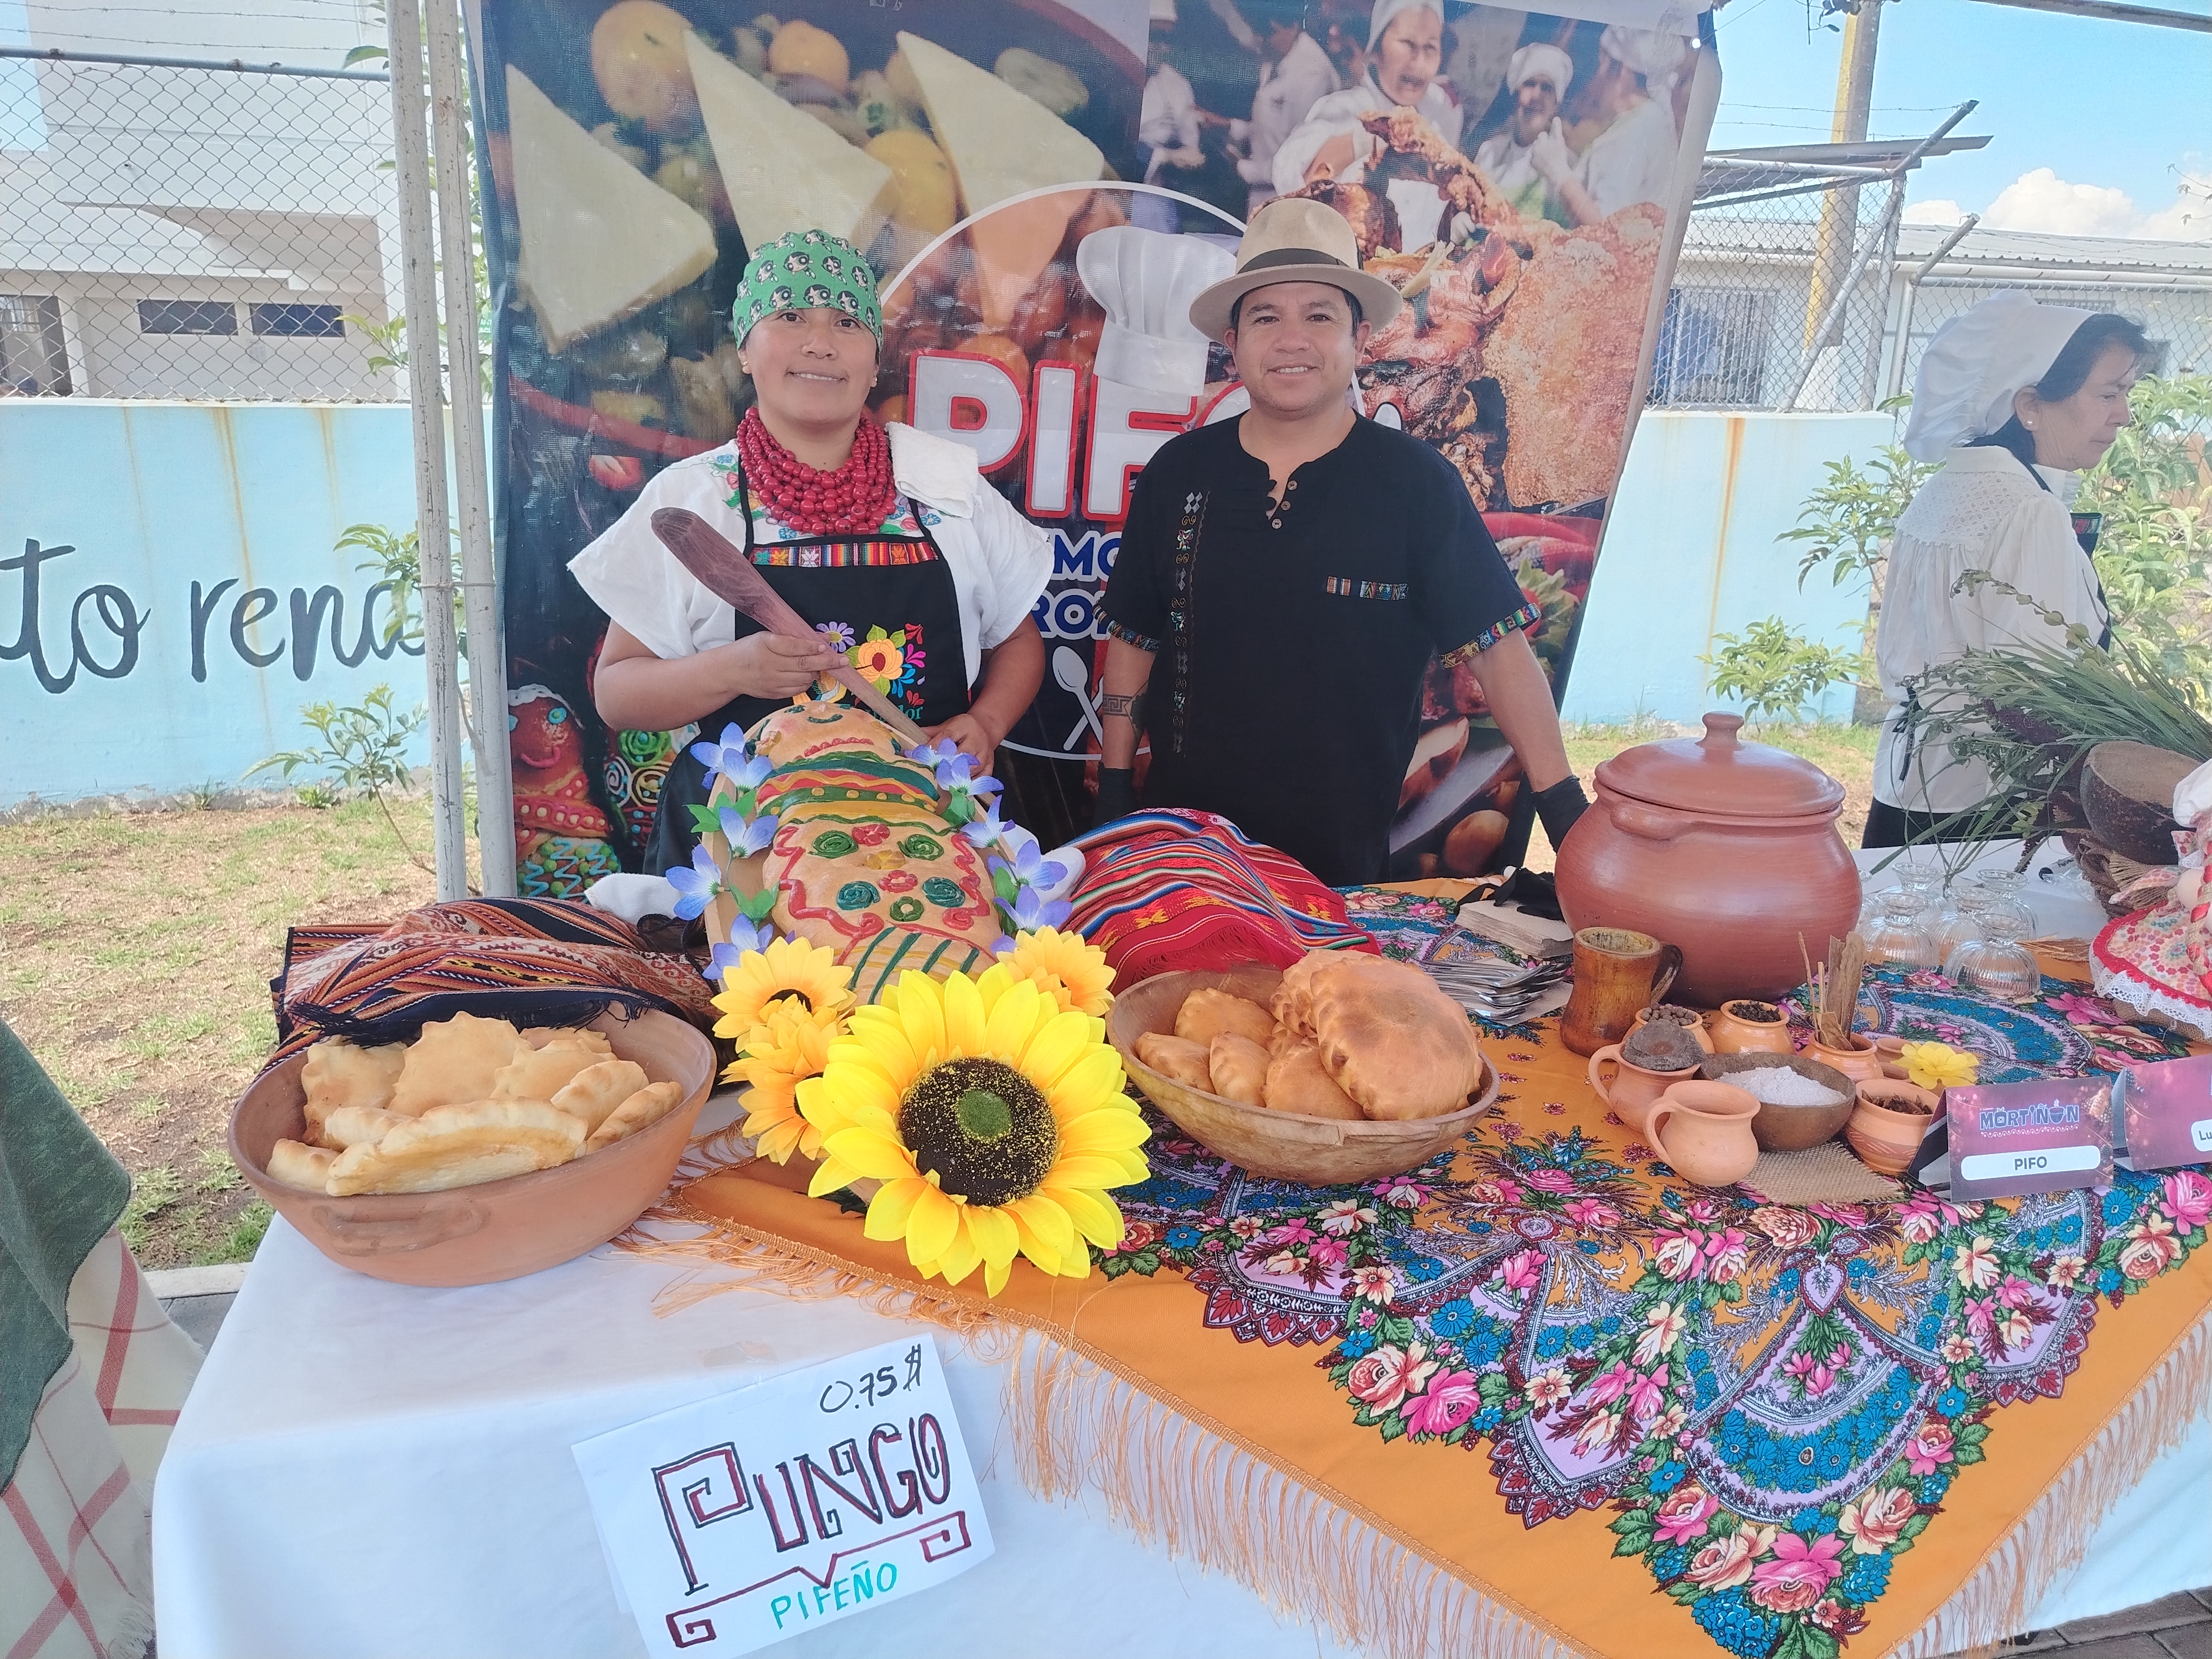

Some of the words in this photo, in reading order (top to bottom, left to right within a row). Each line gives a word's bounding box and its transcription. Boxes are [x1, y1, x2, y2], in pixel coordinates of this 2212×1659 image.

[907, 349, 1251, 521] PIF
[0, 538, 151, 694] to
[190, 577, 426, 683] rena
[2014, 1156, 2047, 1171] PIFO
[651, 1412, 952, 1595] PUNGO
[770, 1559, 898, 1630] PIFEÑO
